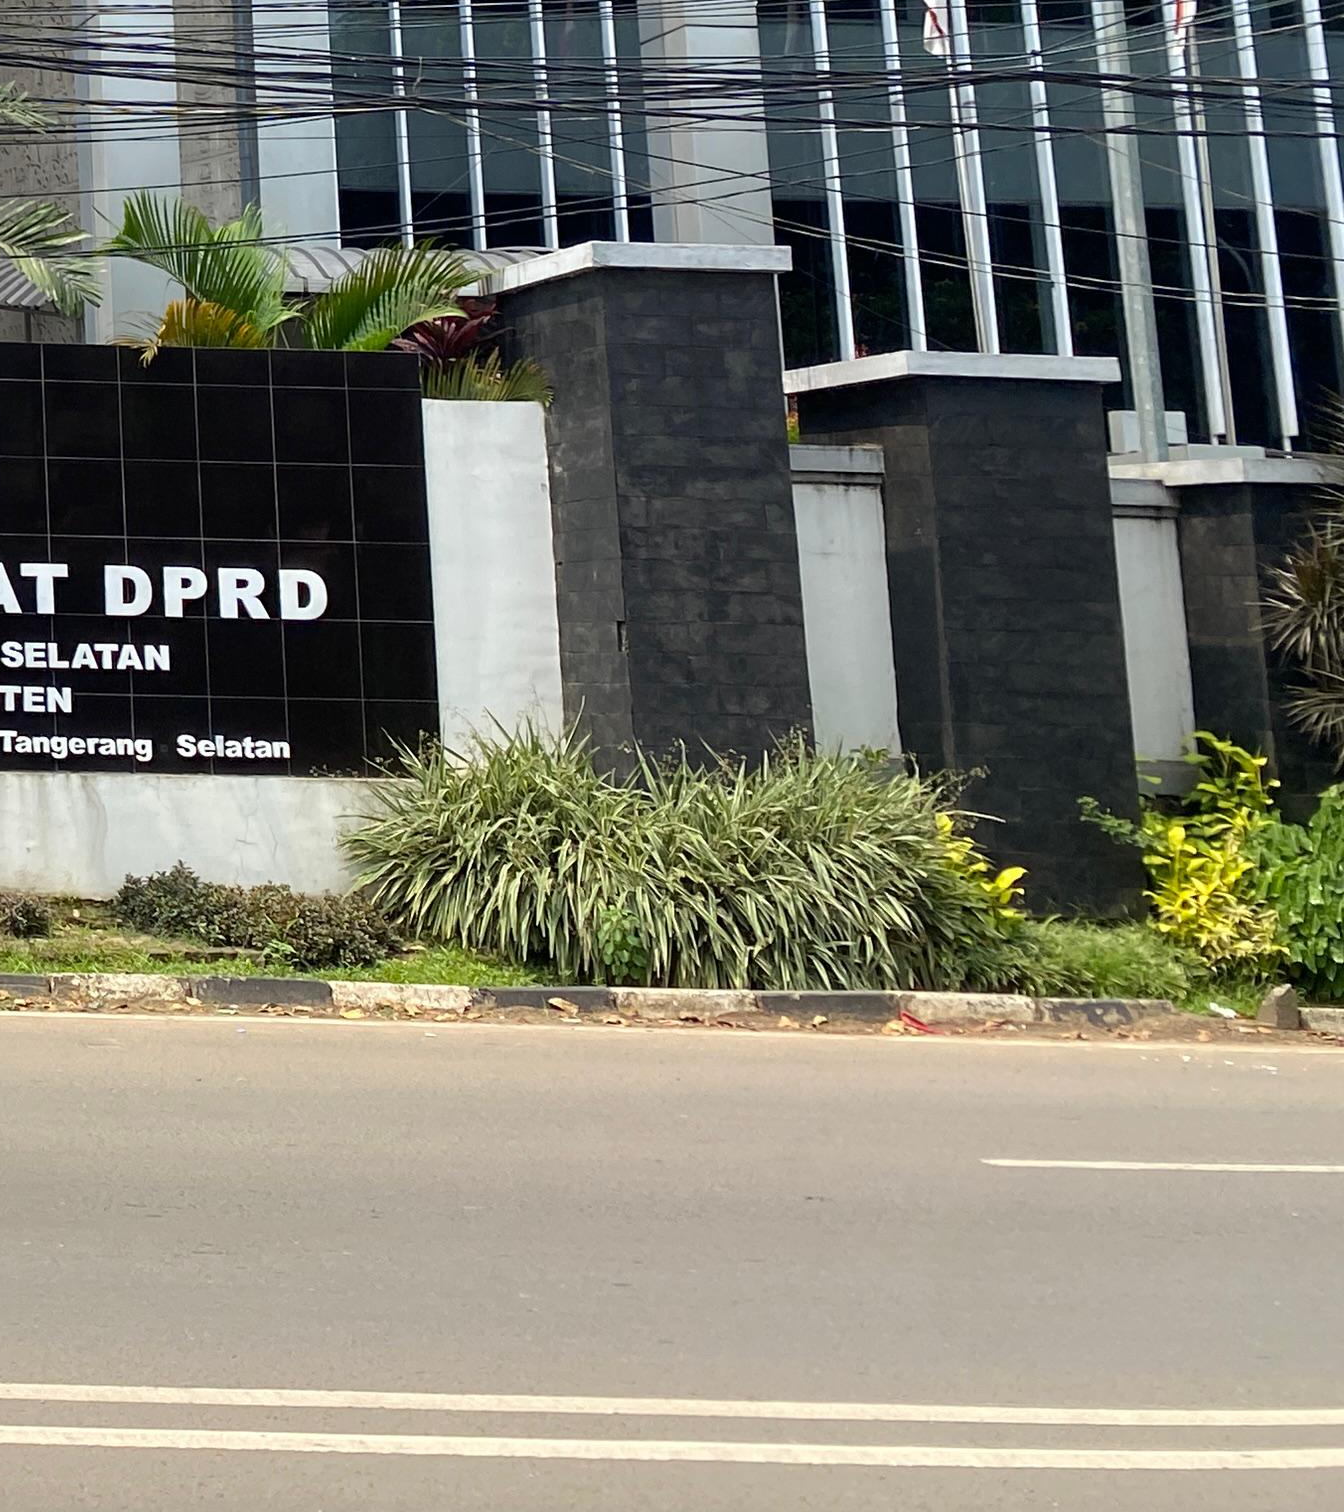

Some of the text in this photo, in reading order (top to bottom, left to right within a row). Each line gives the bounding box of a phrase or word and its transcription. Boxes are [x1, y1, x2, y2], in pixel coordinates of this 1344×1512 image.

[105, 565, 327, 620] DPRD
[1, 641, 170, 670] SELATAN
[177, 735, 290, 758] Selatan
